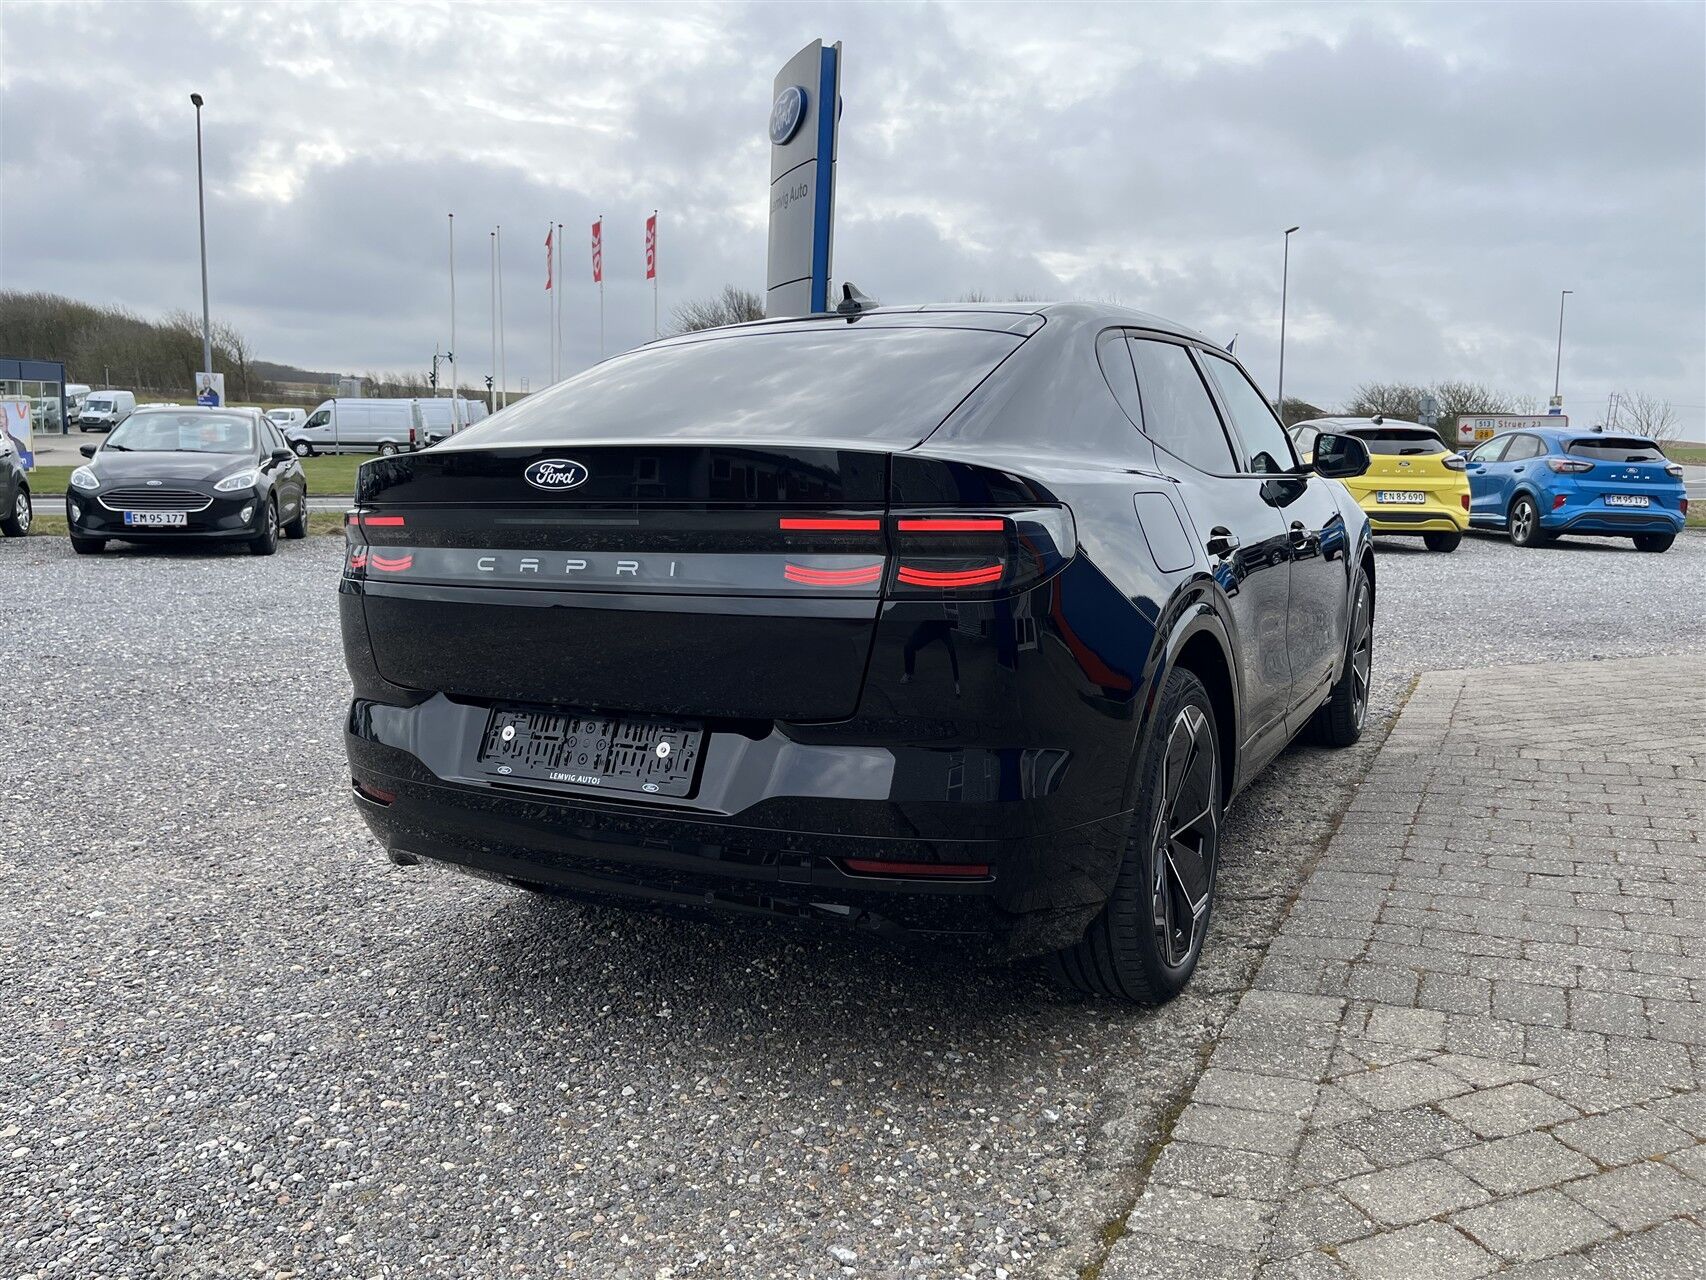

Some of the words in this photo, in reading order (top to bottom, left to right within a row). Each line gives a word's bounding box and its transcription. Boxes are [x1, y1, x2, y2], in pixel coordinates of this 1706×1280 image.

[790, 183, 808, 203] Auto
[1498, 420, 1527, 428] Struer
[535, 462, 576, 485] Ford
[1383, 492, 1395, 500] EN
[1396, 492, 1407, 501] 85
[1408, 493, 1424, 501] 690
[1611, 495, 1622, 503] EM
[132, 513, 147, 523] EM
[149, 513, 163, 523] 95
[166, 513, 185, 523] 177
[477, 557, 676, 577] CAPRI
[549, 772, 576, 782] LEMVIG
